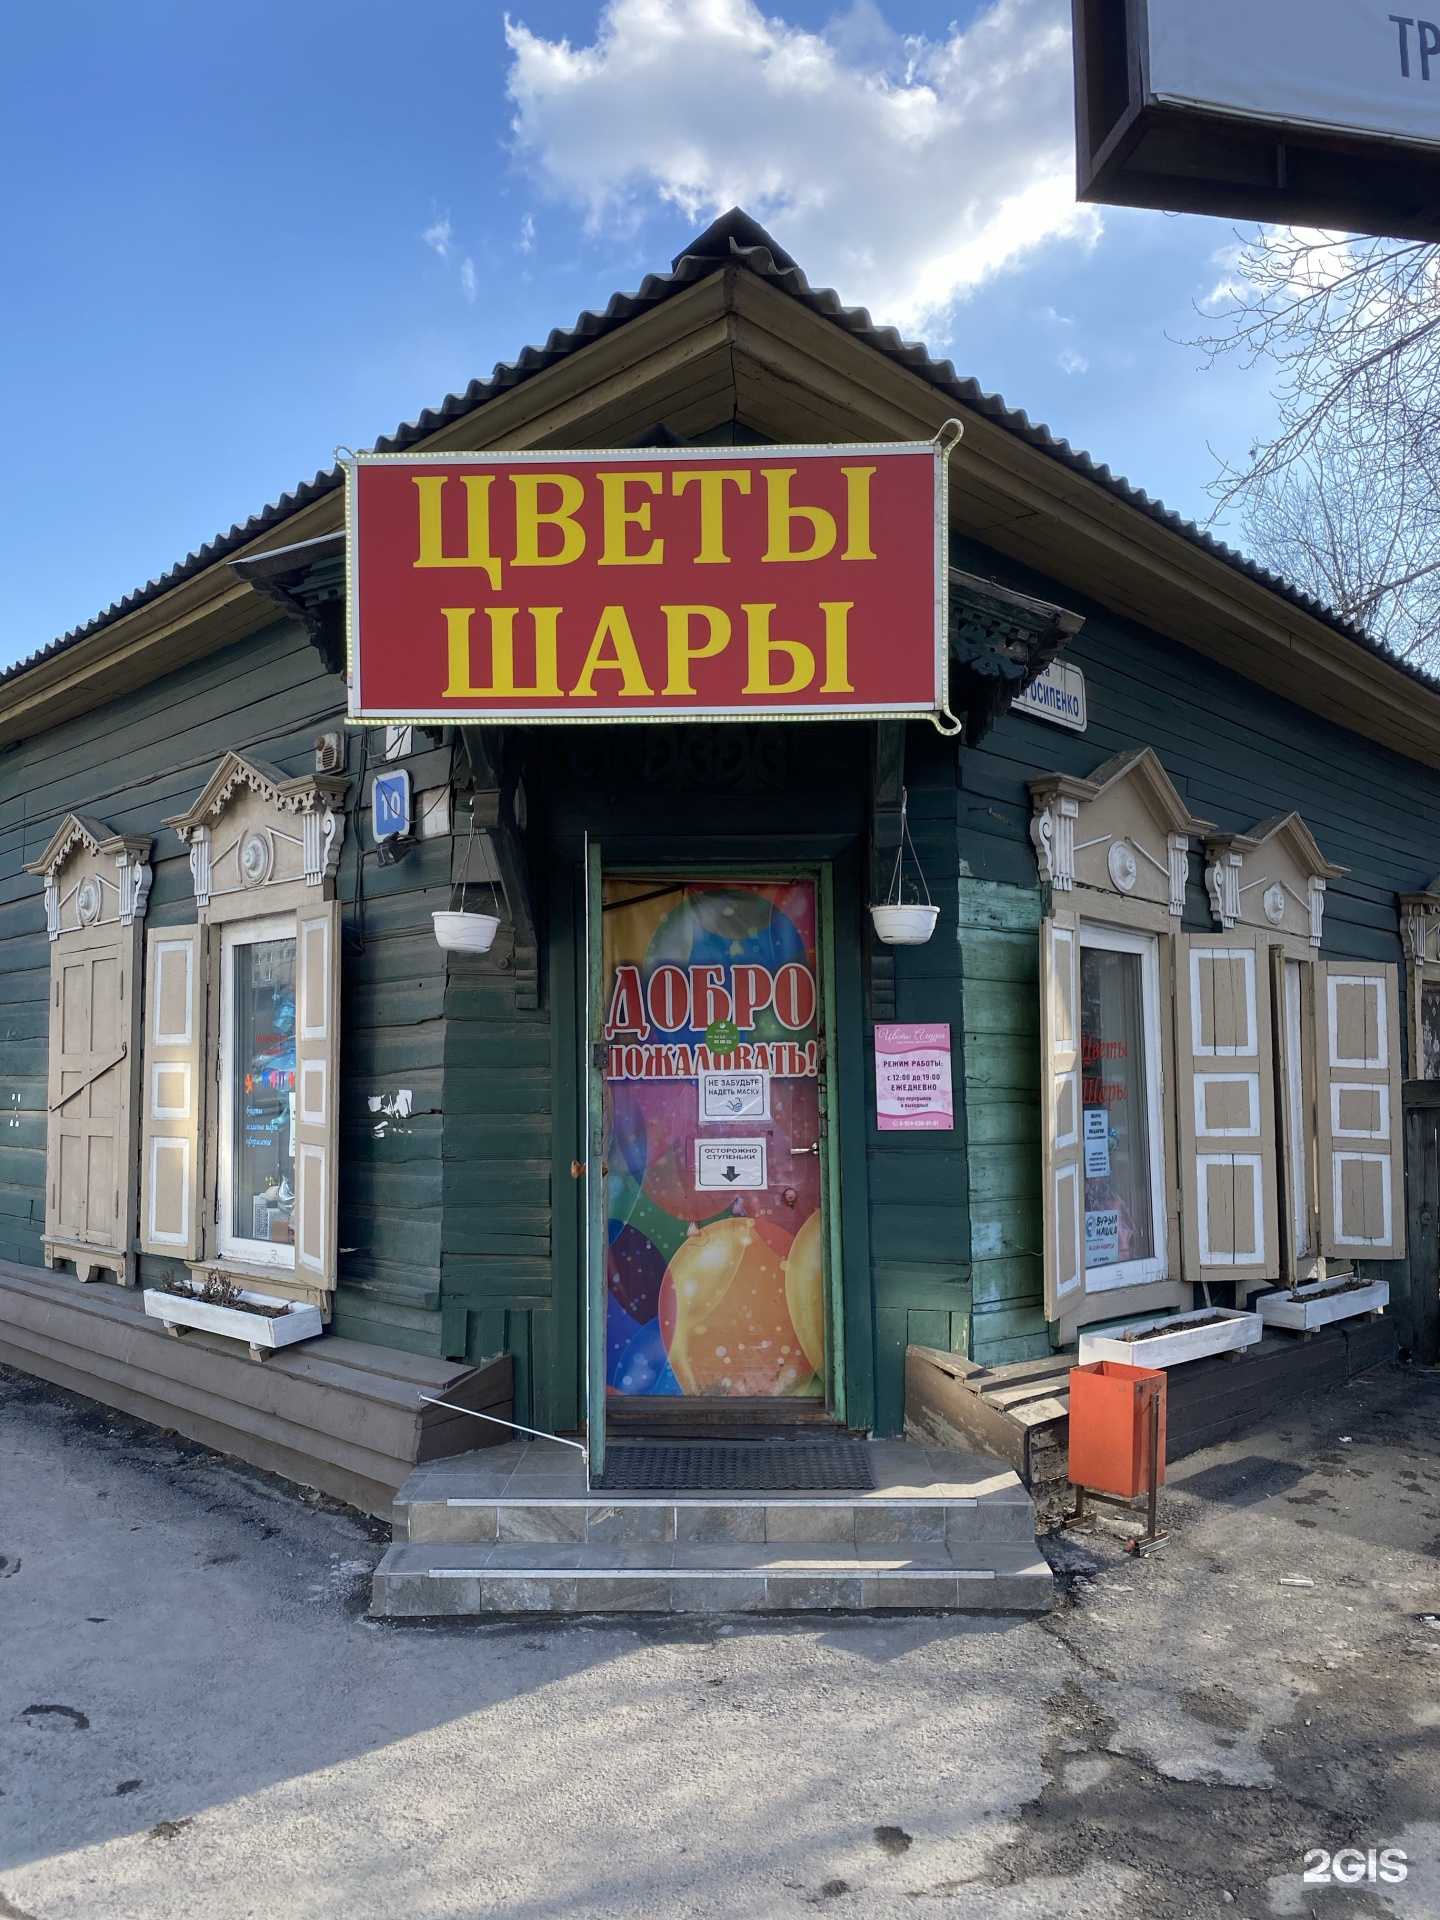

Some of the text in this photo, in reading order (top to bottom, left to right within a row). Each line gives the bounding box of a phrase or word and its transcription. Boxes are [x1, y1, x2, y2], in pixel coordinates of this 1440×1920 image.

[411, 466, 878, 591] ЦВЕТЫ
[440, 601, 856, 698] ШАРЫ
[1030, 681, 1079, 717] ОСИПЕНКО
[380, 790, 401, 821] 10
[605, 963, 816, 1041] ДОБРО
[883, 1060, 909, 1068] РЕЖИМ
[708, 1079, 760, 1087] НЕ ЗАБУДЬТЕ
[708, 1087, 760, 1096] НАДЕТЬ МАСКУ
[890, 1083, 937, 1091] ЕЖЕДНЕВНО
